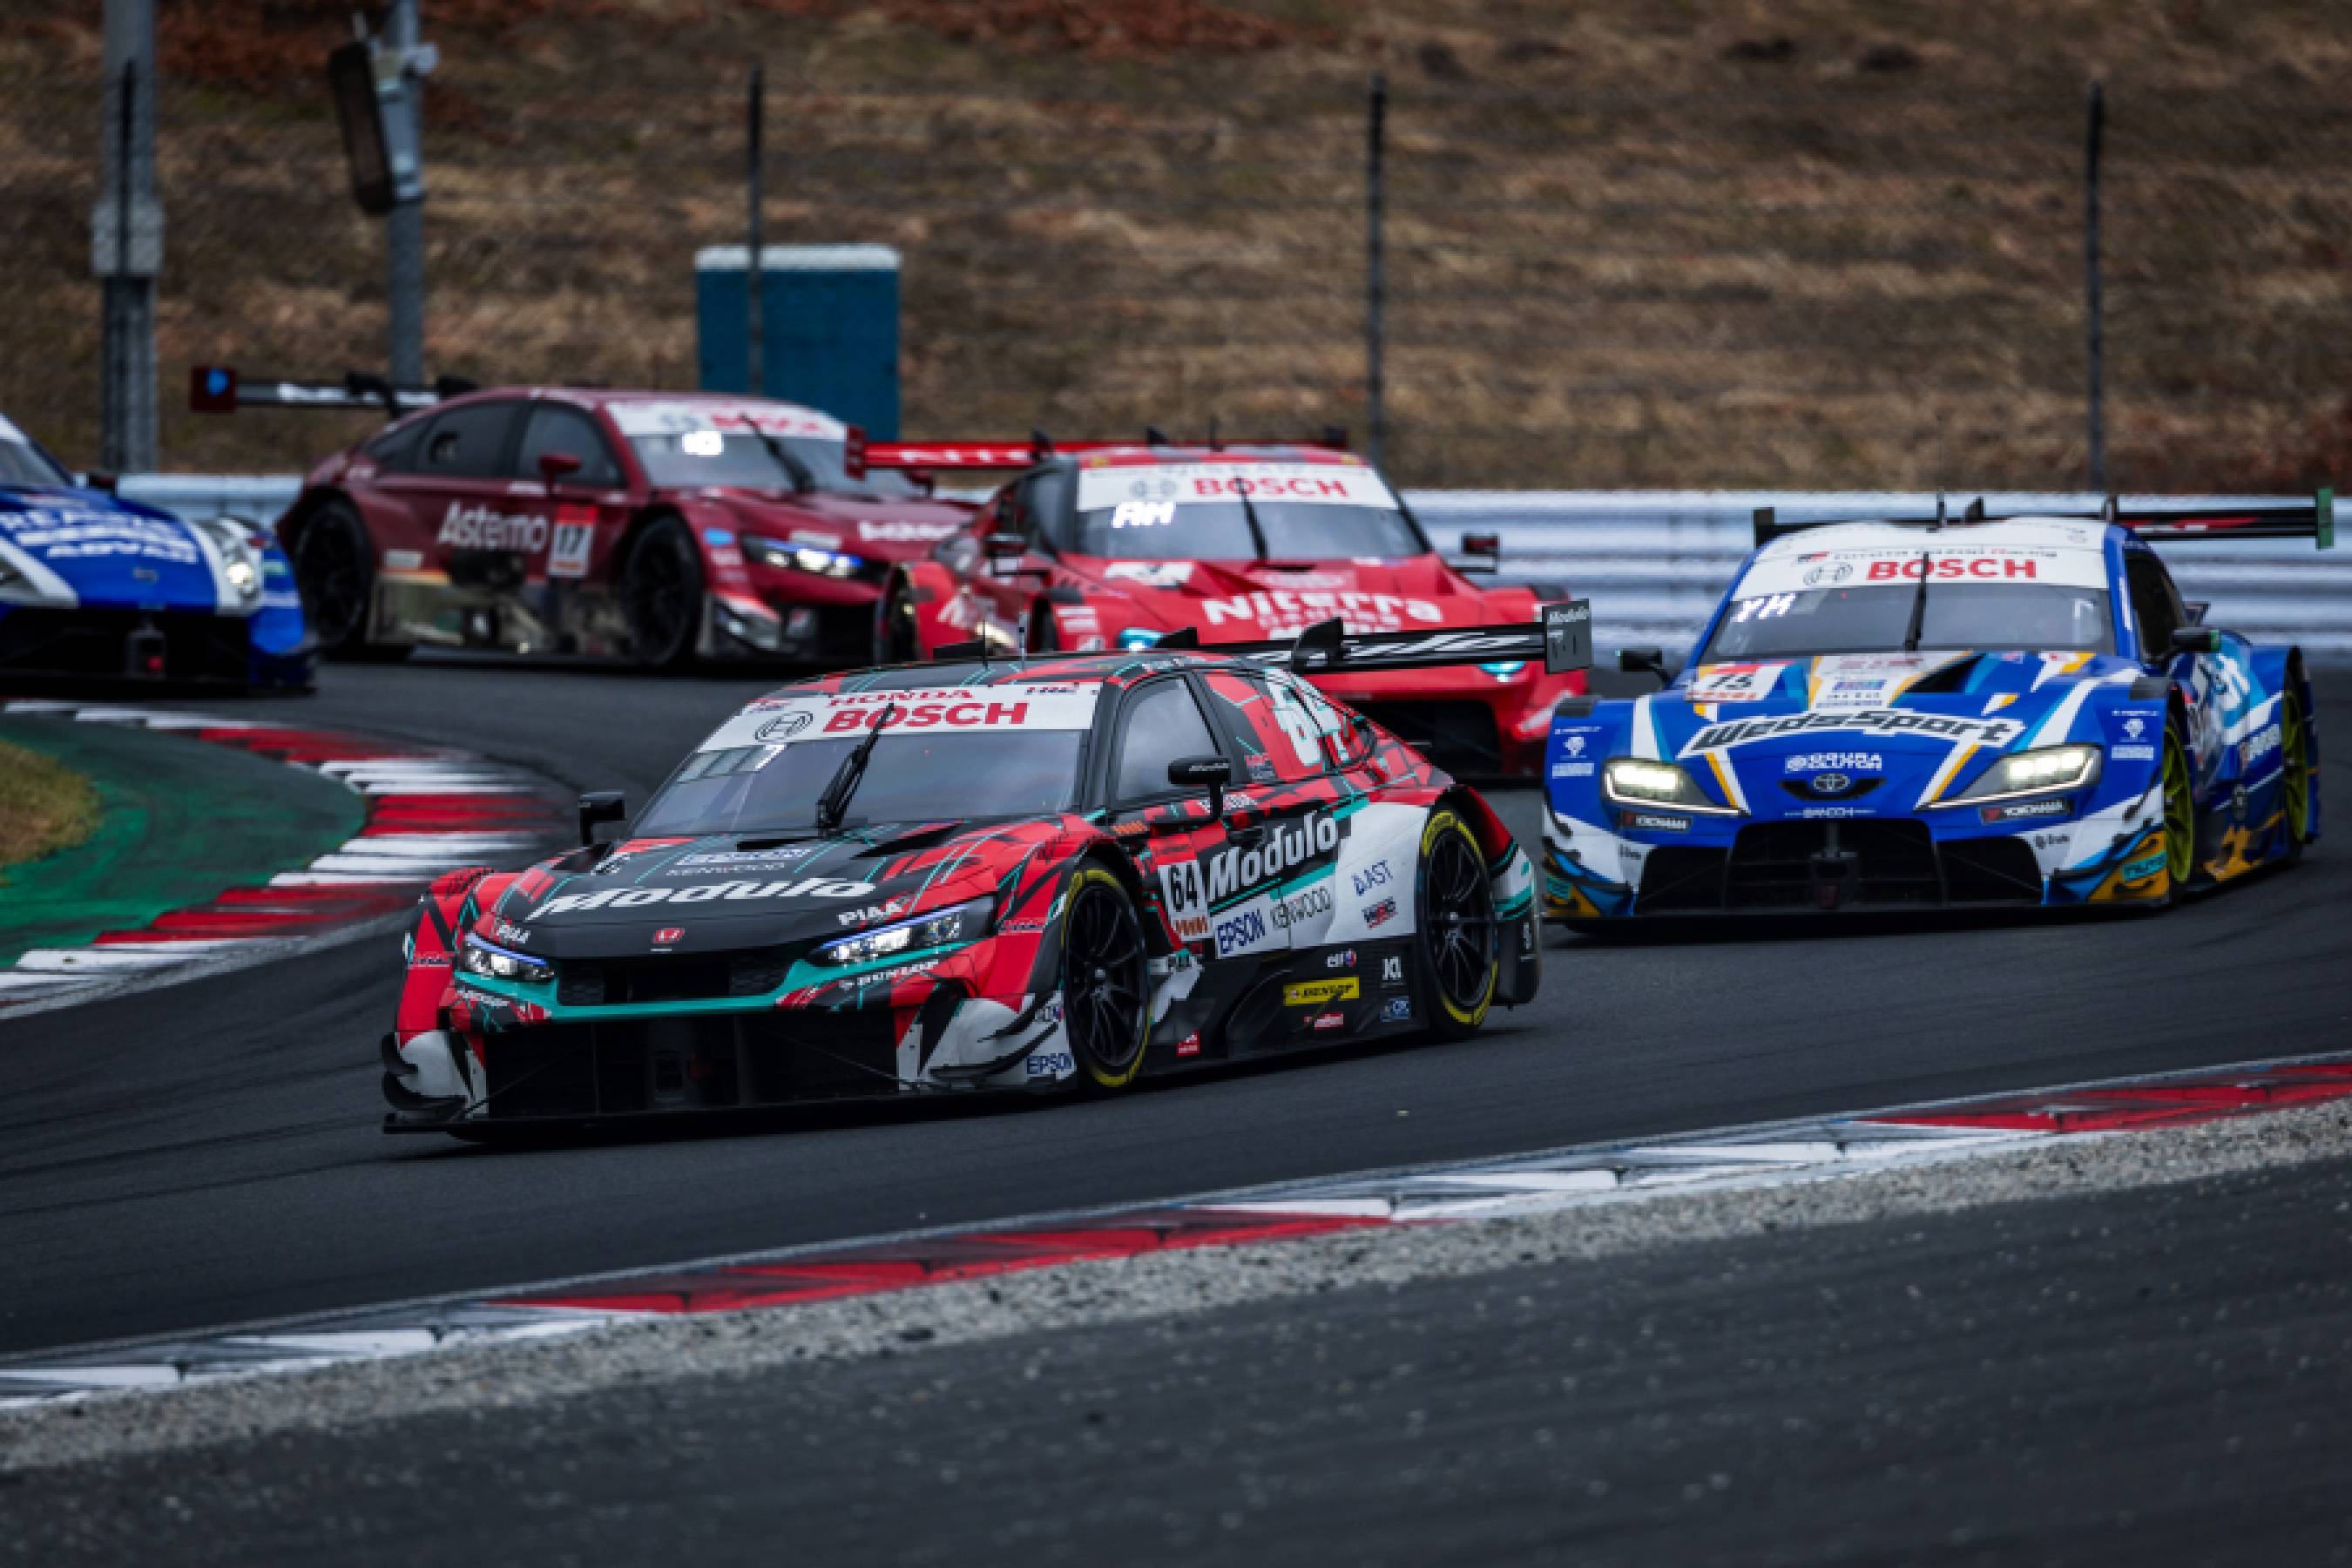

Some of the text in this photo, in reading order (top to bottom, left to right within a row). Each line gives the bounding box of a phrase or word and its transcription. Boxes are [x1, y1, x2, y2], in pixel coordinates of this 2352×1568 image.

[1194, 476, 1349, 497] BOSCH
[438, 498, 548, 552] Astemo
[1867, 558, 2038, 581] BOSCH
[1200, 591, 1443, 625] Niterra
[824, 689, 975, 709] HONDA
[822, 701, 1030, 733] BOSCH
[1207, 809, 1339, 903] Modulo
[524, 875, 877, 922] Modulo
[1168, 862, 1199, 913] 64
[837, 899, 903, 926] PIAA
[1216, 906, 1267, 956] EPSON
[1025, 1051, 1073, 1075] EPSON
